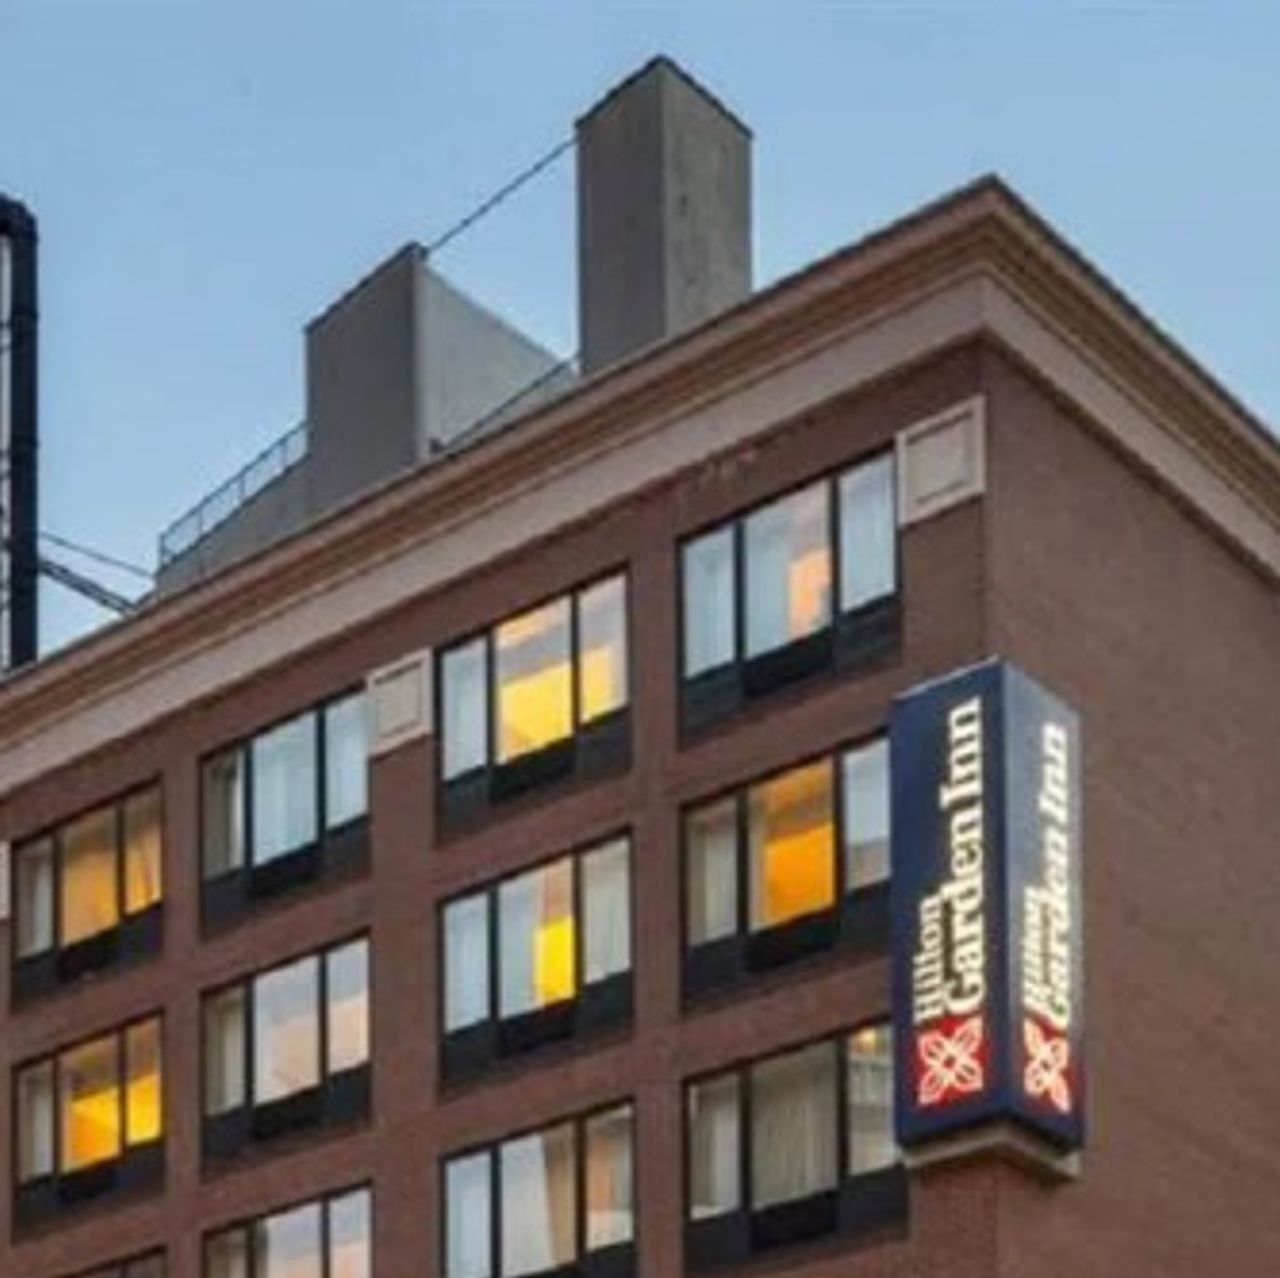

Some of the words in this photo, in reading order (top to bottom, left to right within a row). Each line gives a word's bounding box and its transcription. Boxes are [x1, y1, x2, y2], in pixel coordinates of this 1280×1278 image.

[939, 696, 983, 811] Inn
[1039, 722, 1068, 824] Inn
[912, 895, 944, 1025] Hilton
[940, 808, 985, 1015] Garden
[1039, 828, 1069, 1030] Garden
